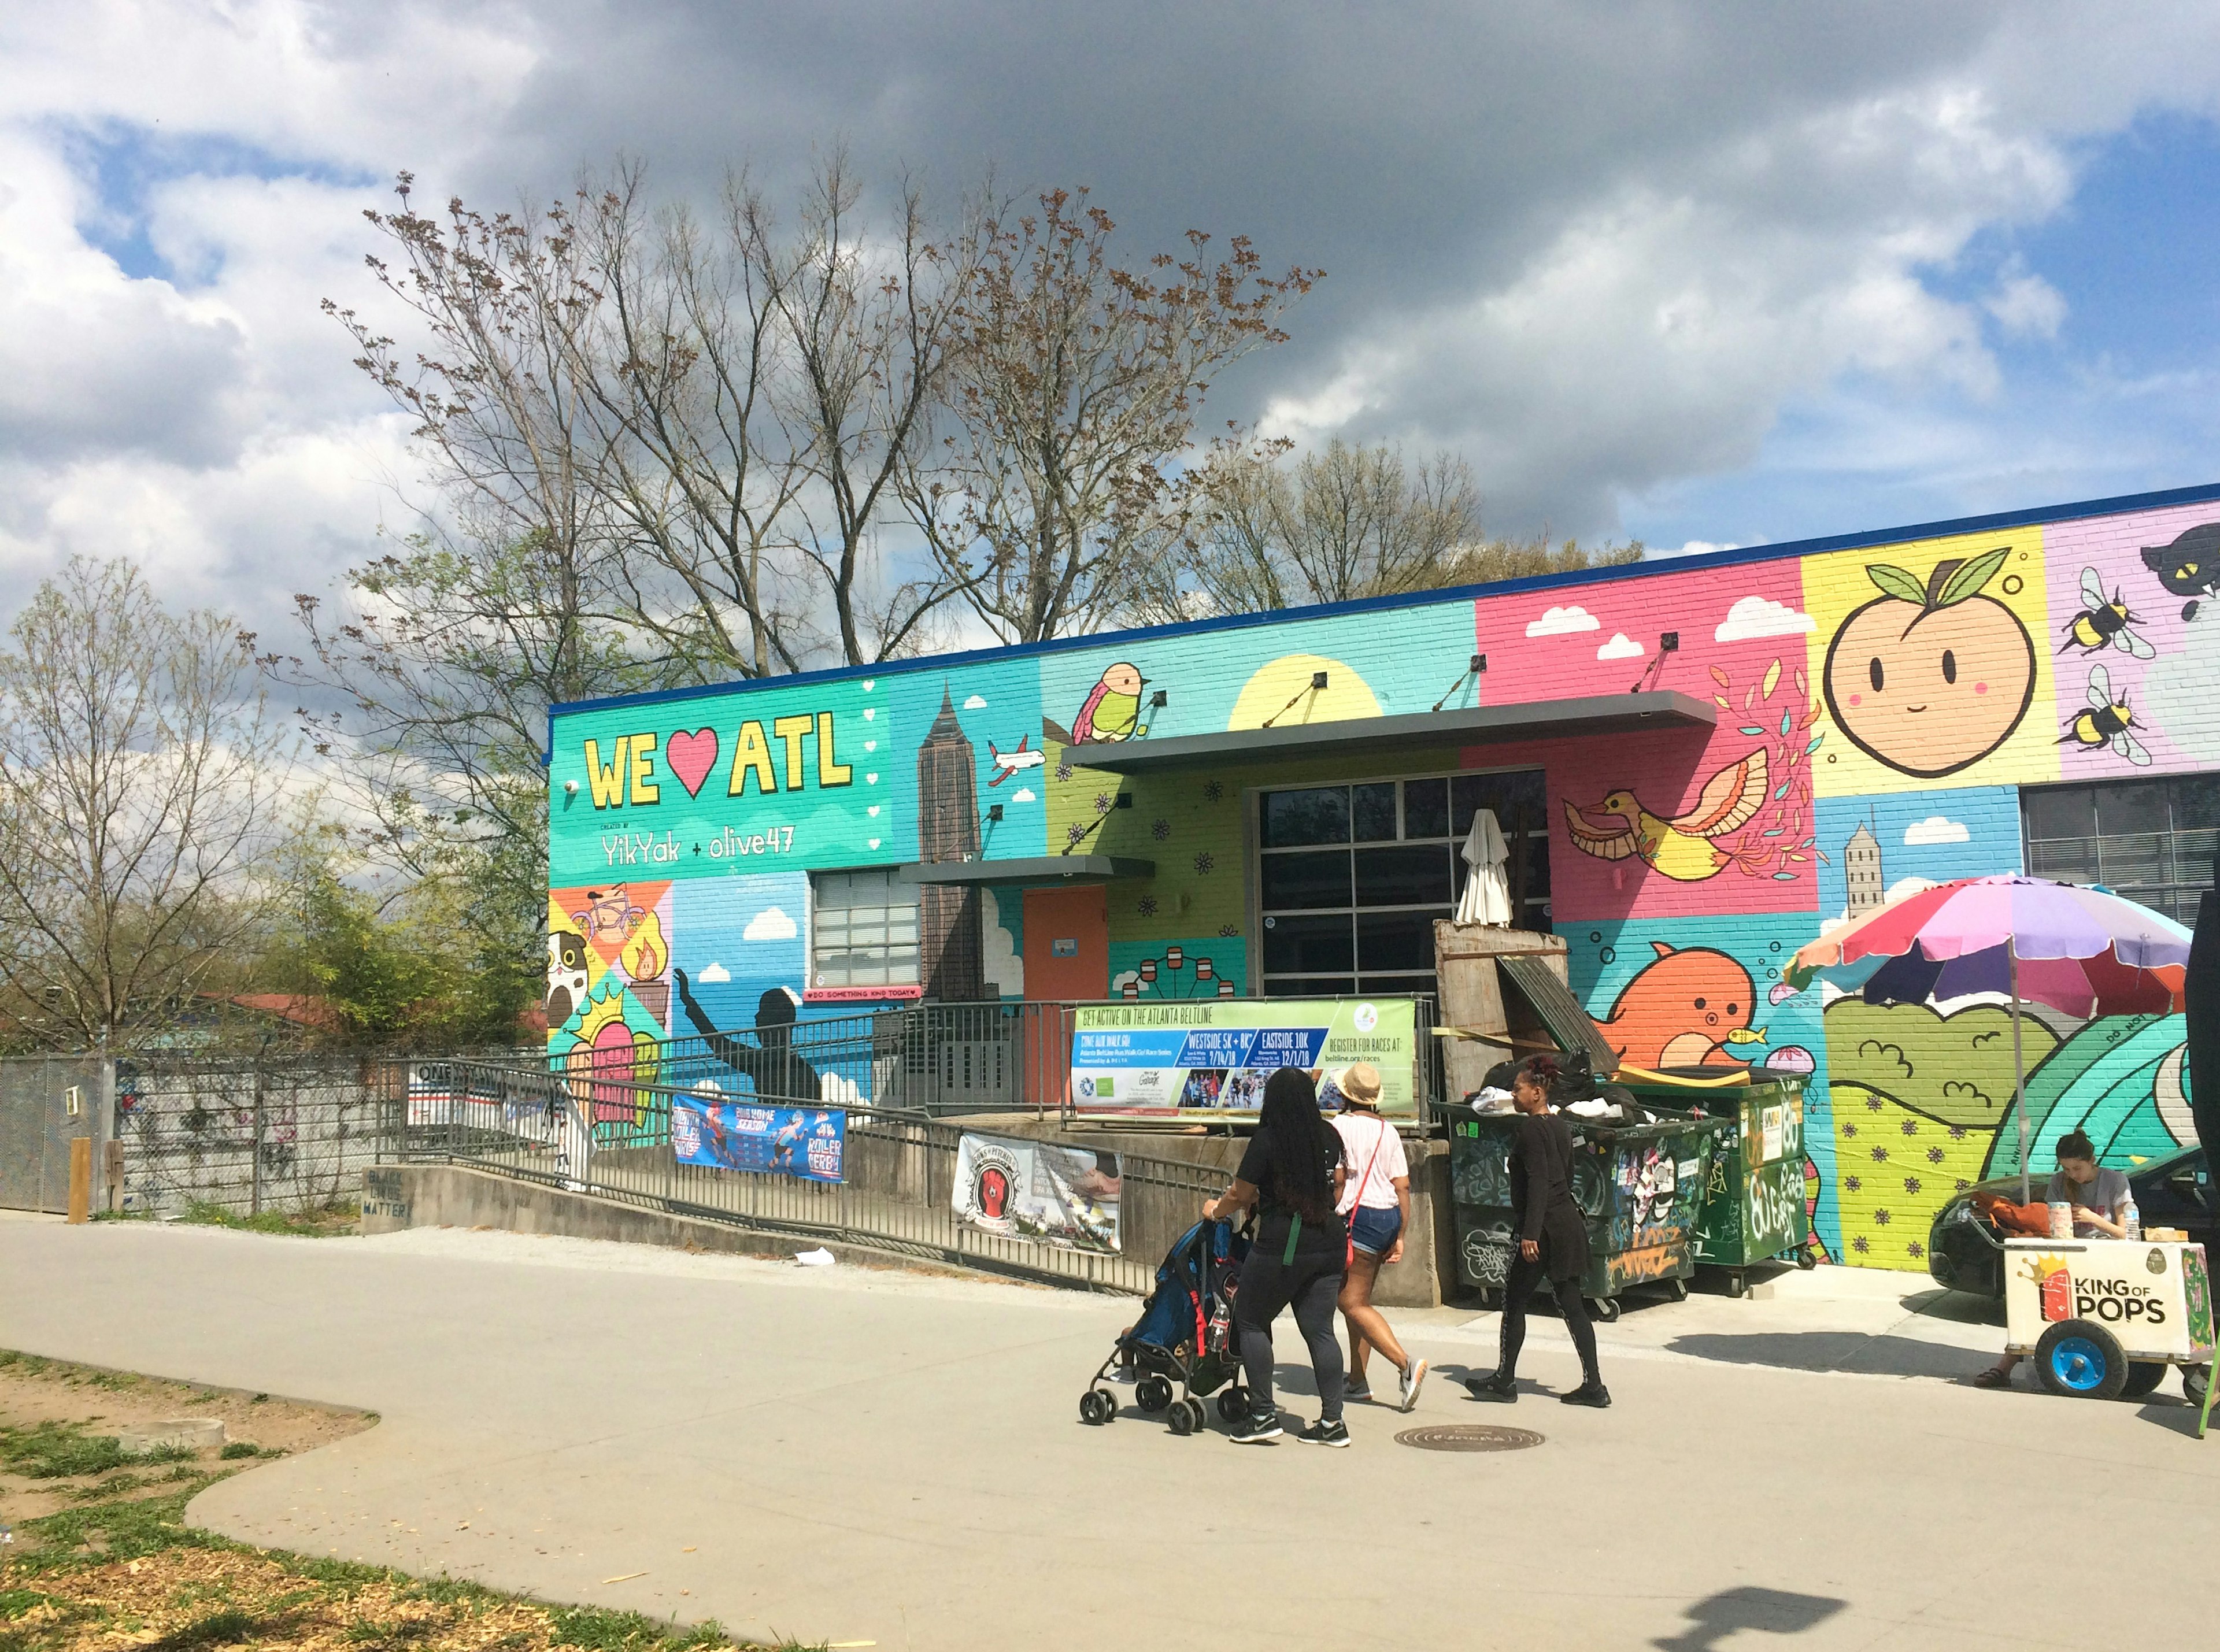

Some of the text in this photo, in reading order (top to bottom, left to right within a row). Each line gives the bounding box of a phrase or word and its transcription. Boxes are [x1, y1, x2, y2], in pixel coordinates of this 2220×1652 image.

[583, 710, 853, 810] WE ATL
[601, 830, 681, 866] YikYak
[709, 825, 796, 858] olive47
[1083, 1006, 1213, 1026] GET ACTIVE ON THE ATLANTA BELTLINE
[1189, 1032, 1222, 1049] WESTSIDE
[1223, 1033, 1232, 1049] 5K
[1261, 1032, 1309, 1049] EASTSIDE 10K
[1330, 1038, 1357, 1053] REGISTER
[1359, 1038, 1370, 1052] FOR
[1372, 1038, 1390, 1052] RACES
[1209, 1050, 1235, 1066] 7/14/18
[1282, 1050, 1309, 1066] 12/1/18
[1325, 1054, 1381, 1062] beltline.org/races
[751, 1108, 775, 1121] HOME
[736, 1119, 769, 1131] SEASON
[808, 1138, 842, 1155] ROLLER
[808, 1153, 839, 1172] DERBY
[974, 1149, 987, 1165] SONS
[991, 1147, 1012, 1164] PITCHES
[364, 1200, 406, 1217] MATTER
[2074, 1278, 2151, 1297] KING OF
[2076, 1297, 2166, 1324] POPS
